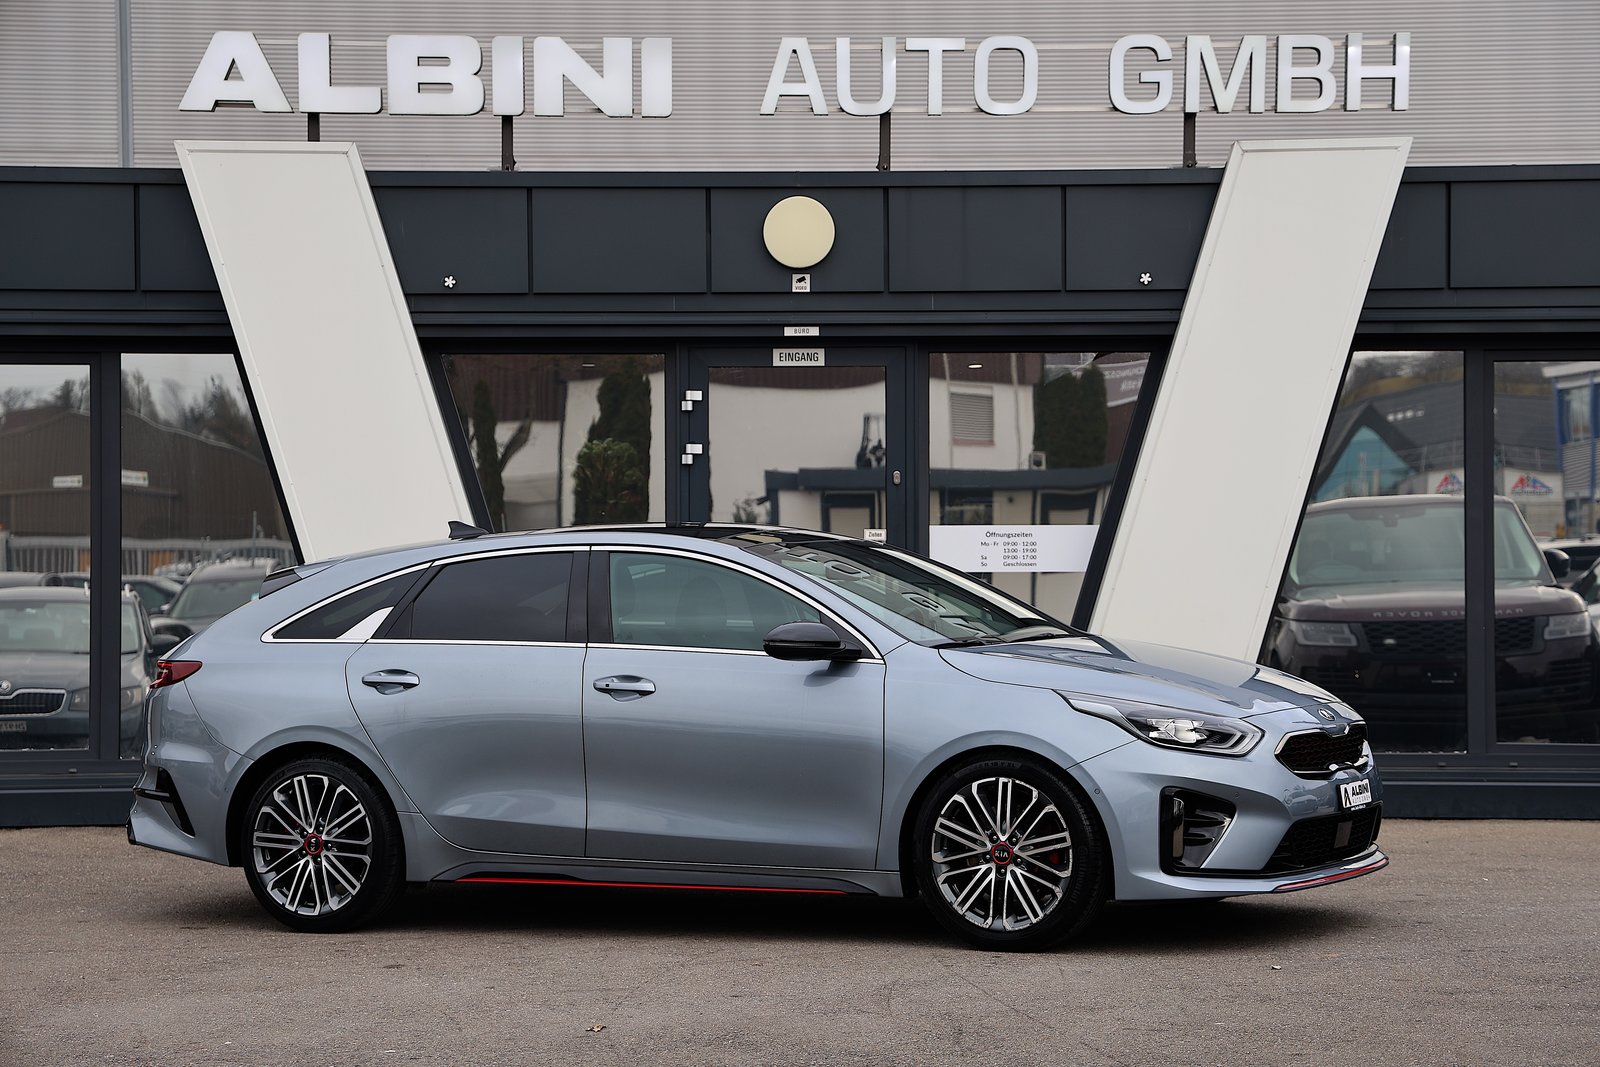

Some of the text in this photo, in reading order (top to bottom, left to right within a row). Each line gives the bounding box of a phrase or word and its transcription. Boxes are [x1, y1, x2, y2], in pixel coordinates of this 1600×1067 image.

[179, 31, 1411, 117] ALBINI AUTO GMBH
[779, 352, 819, 362] EINGANG
[994, 850, 1009, 858] KIA
